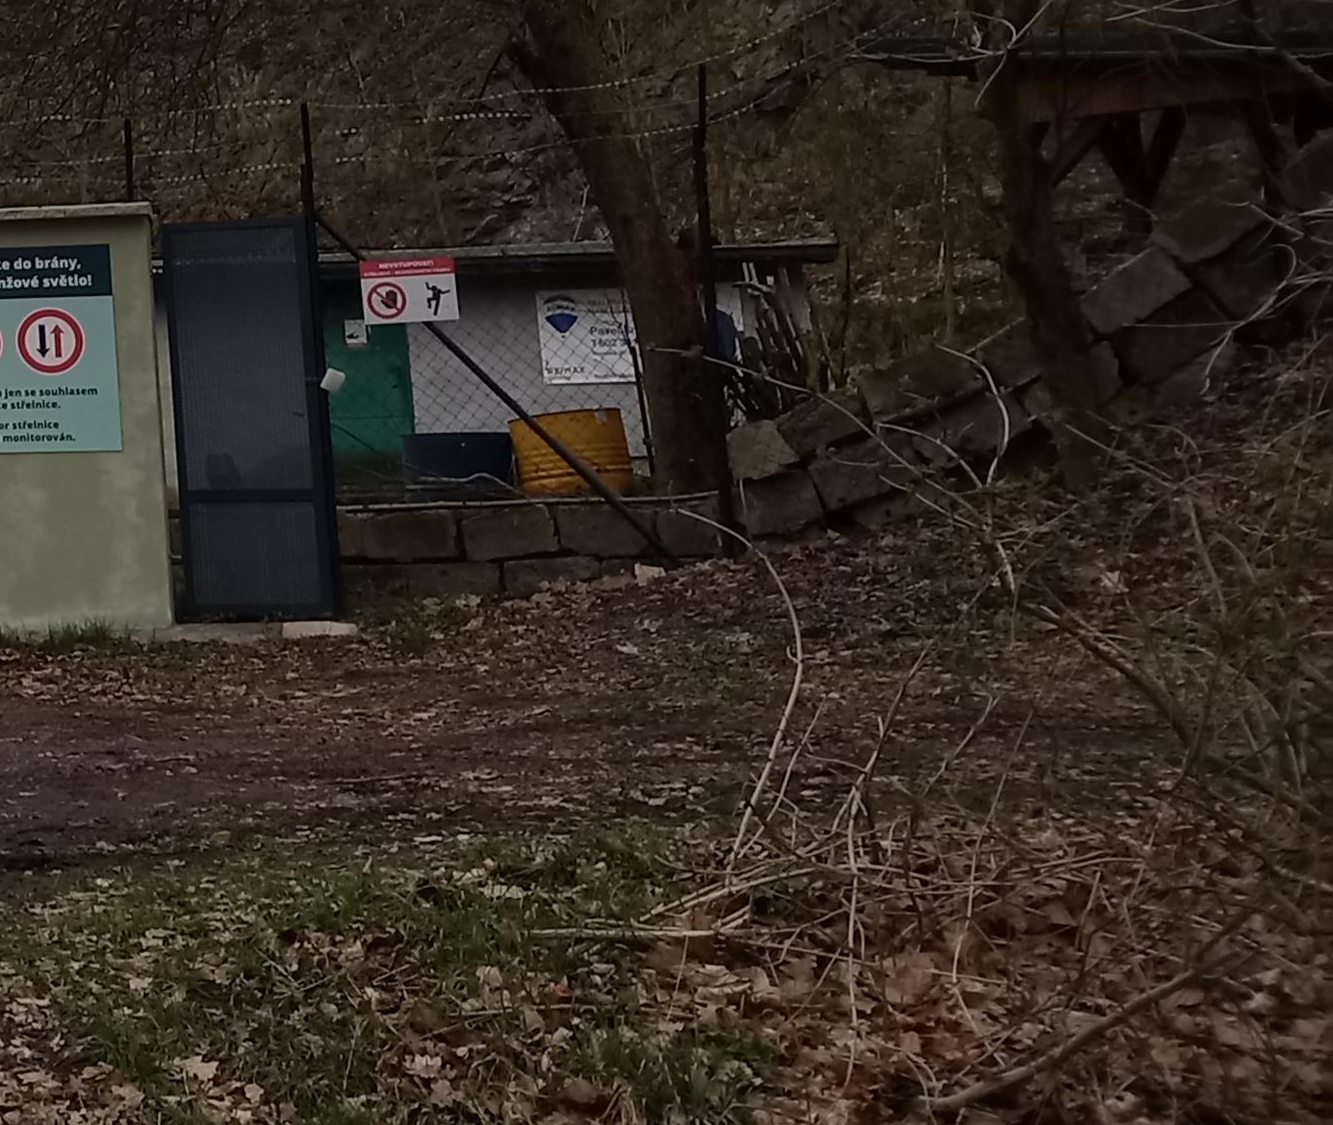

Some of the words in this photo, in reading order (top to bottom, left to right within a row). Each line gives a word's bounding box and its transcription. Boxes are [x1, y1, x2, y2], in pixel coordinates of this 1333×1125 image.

[14, 258, 32, 270] do
[35, 256, 81, 271] brány,
[43, 274, 92, 287] světlo!
[4, 388, 22, 399] jen
[25, 389, 36, 397] se
[39, 387, 98, 397] souhlasem
[11, 400, 61, 410] střelnice.
[12, 420, 59, 430] střelnice
[3, 432, 76, 443] monitorován.
